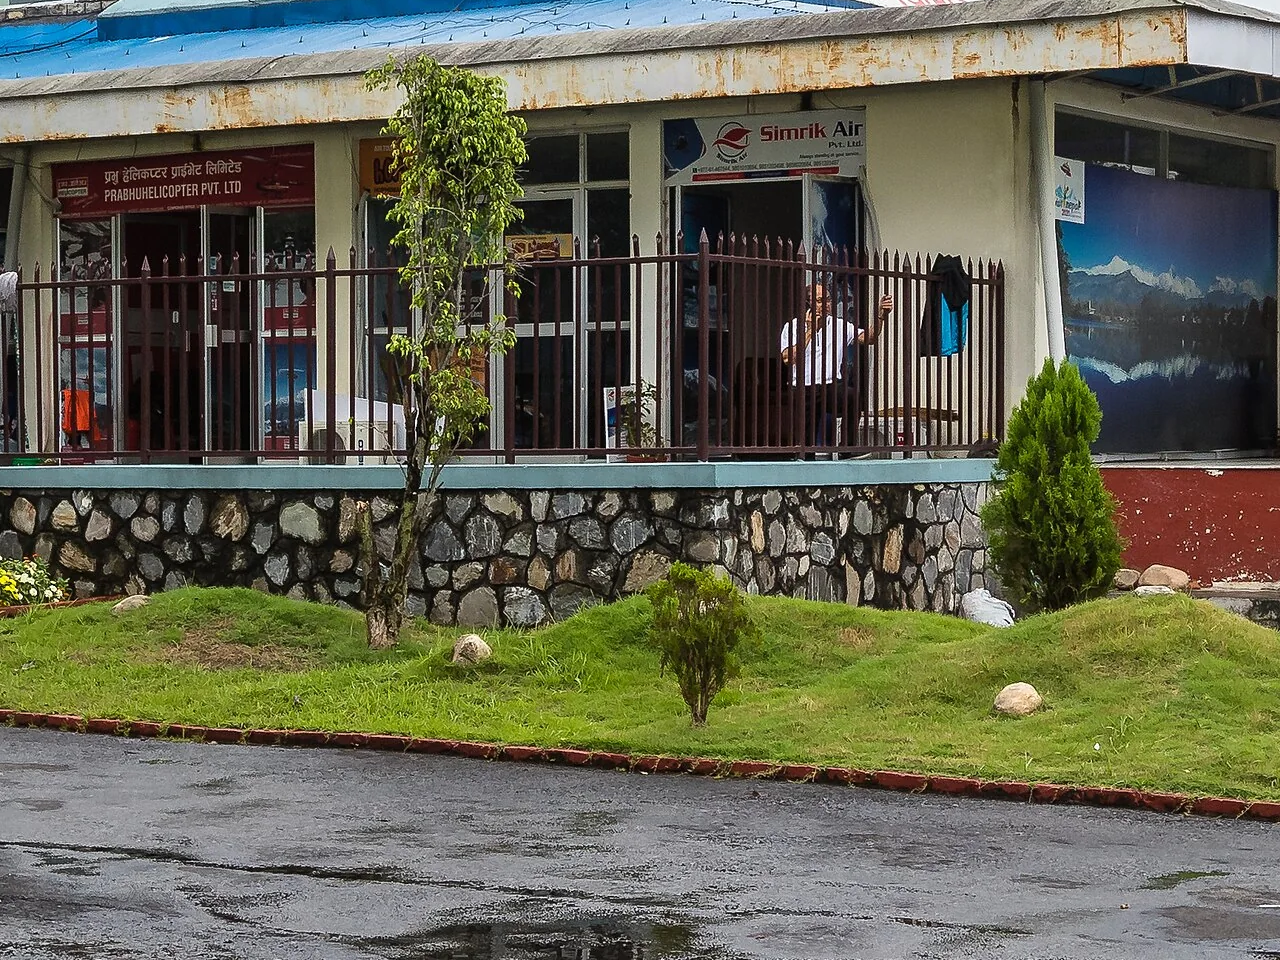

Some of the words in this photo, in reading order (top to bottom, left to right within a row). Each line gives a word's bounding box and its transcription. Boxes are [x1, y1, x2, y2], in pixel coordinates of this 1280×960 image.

[760, 123, 827, 142] Simrik
[832, 120, 864, 138] Air
[828, 141, 846, 149] Pvt.
[847, 139, 864, 148] Ltd.
[104, 170, 119, 186] प्रभु
[104, 183, 199, 202] PRABHUHELICOPTER
[224, 180, 242, 194] LTD
